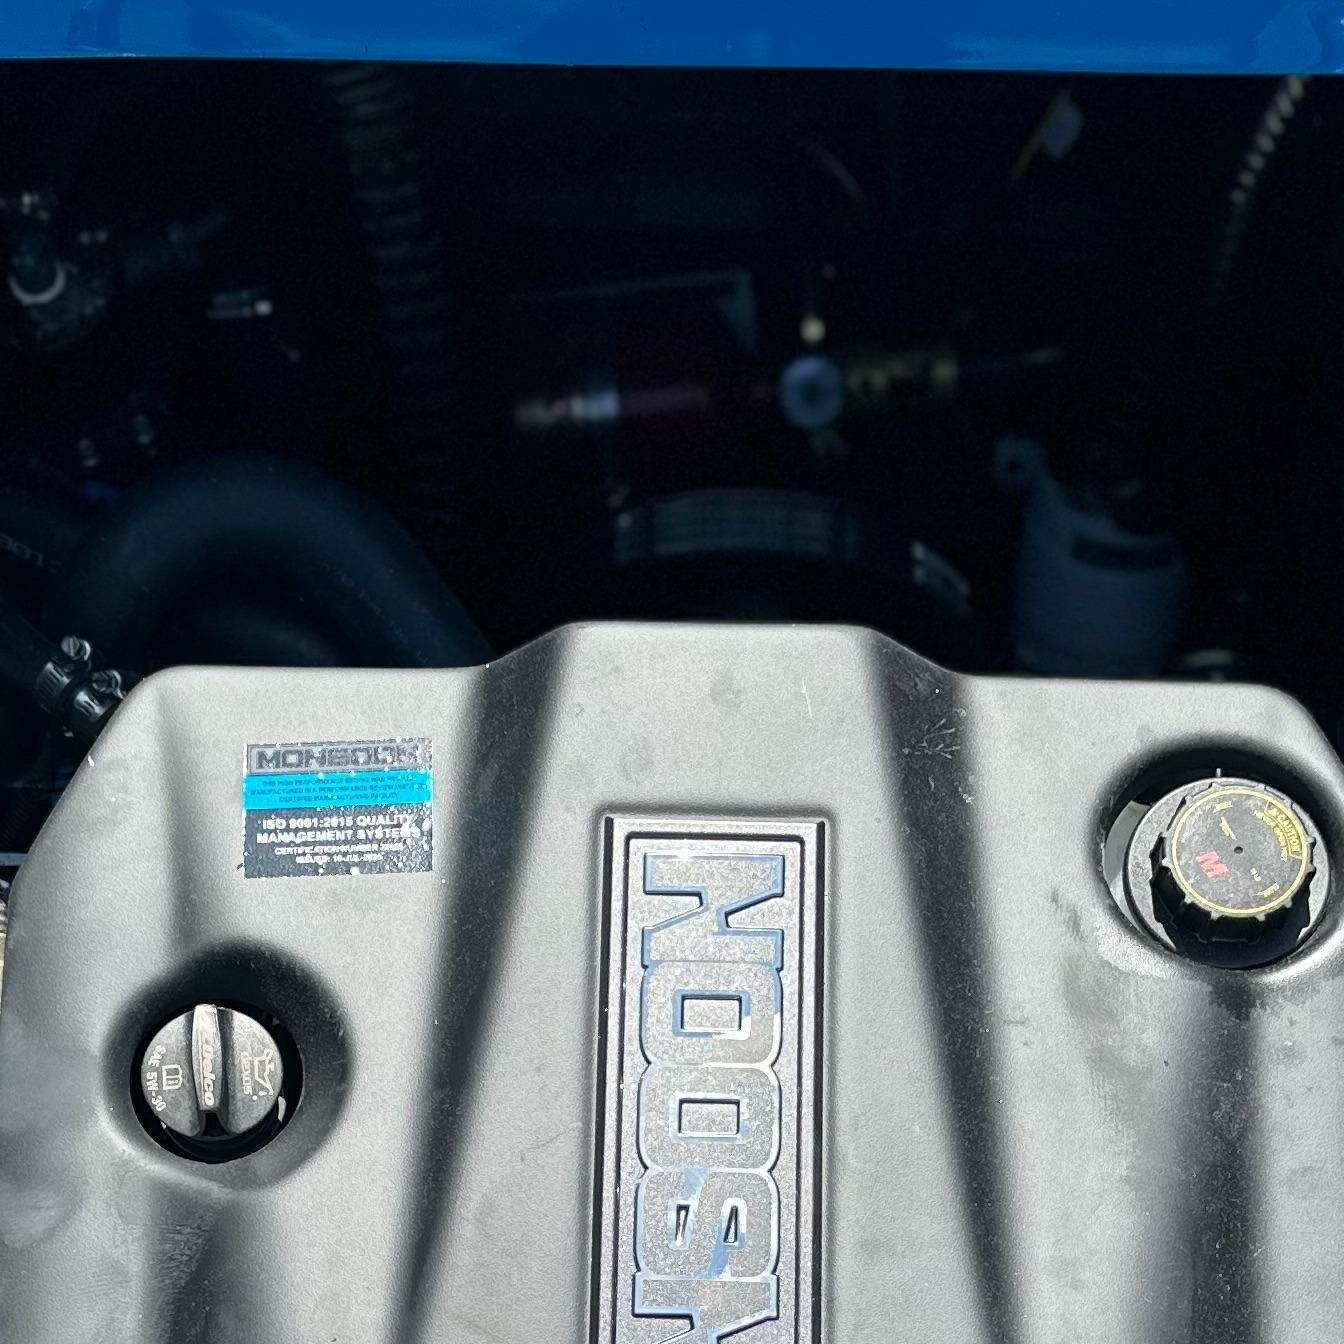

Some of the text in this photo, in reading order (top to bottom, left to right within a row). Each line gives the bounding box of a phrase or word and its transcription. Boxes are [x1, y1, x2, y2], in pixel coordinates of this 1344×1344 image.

[257, 829, 354, 844] MANAGEMENT
[263, 818, 286, 830] ISO
[356, 813, 414, 827] QUALITY
[146, 1045, 166, 1111] SAE 5W-30
[240, 1052, 252, 1095] dexos
